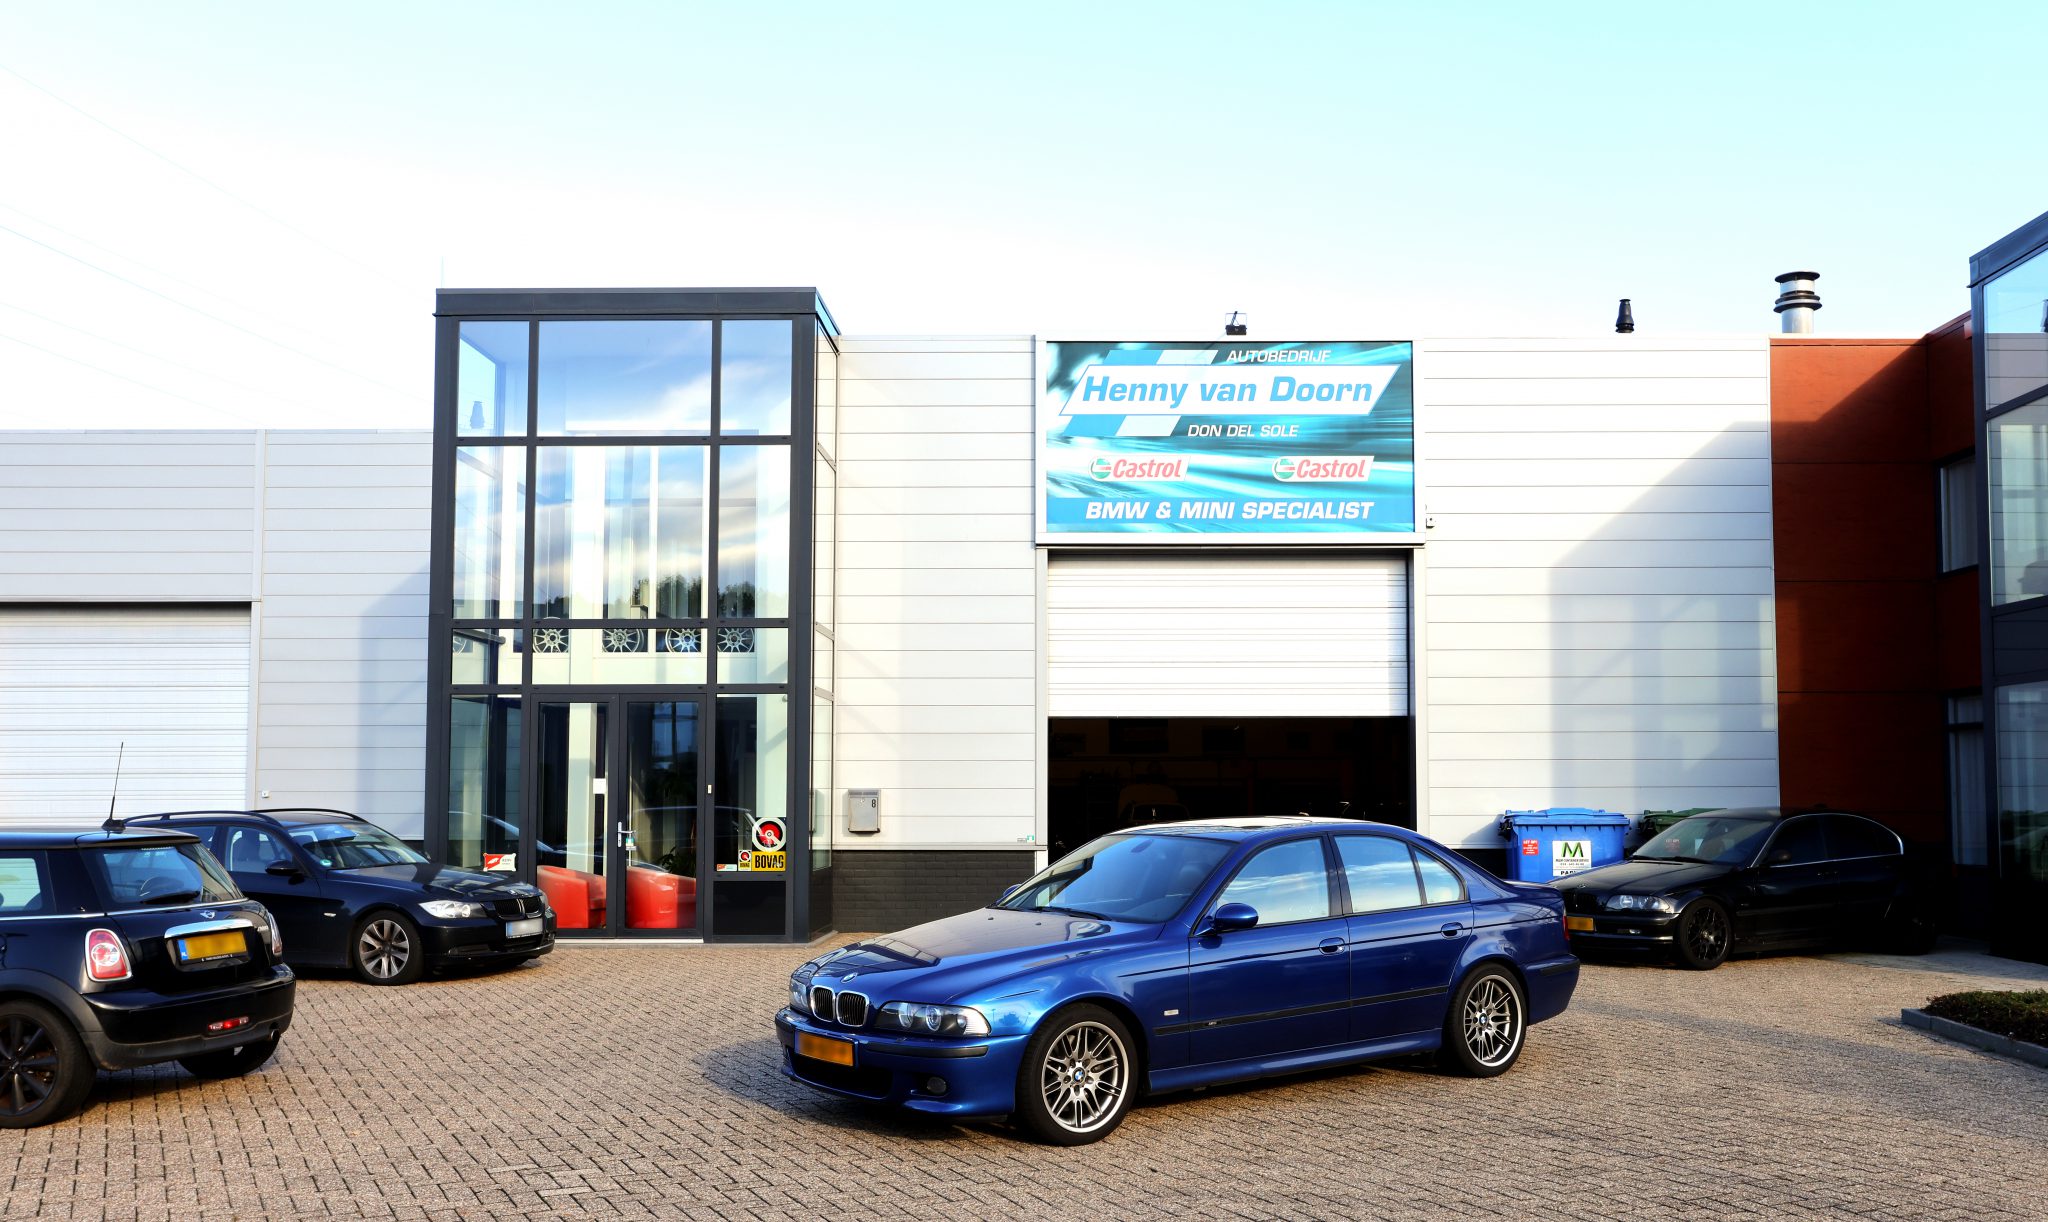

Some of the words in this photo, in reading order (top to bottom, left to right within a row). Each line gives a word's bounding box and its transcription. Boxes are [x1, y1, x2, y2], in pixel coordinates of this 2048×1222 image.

[1226, 350, 1331, 363] AUTOBEDRIJF
[1082, 375, 1189, 409] Henny
[1200, 383, 1257, 402] van
[1269, 376, 1373, 402] Doorn
[1187, 424, 1222, 437] DON
[1226, 424, 1255, 437] DEL
[1259, 424, 1299, 437] SOLE
[1112, 459, 1182, 478] Castrol
[1296, 459, 1366, 478] Castrol
[1085, 501, 1150, 519] BMW
[1155, 501, 1171, 519] &
[1179, 501, 1236, 519] MINI
[1241, 501, 1375, 519] SPECIALIST
[754, 854, 784, 869] BOVAG
